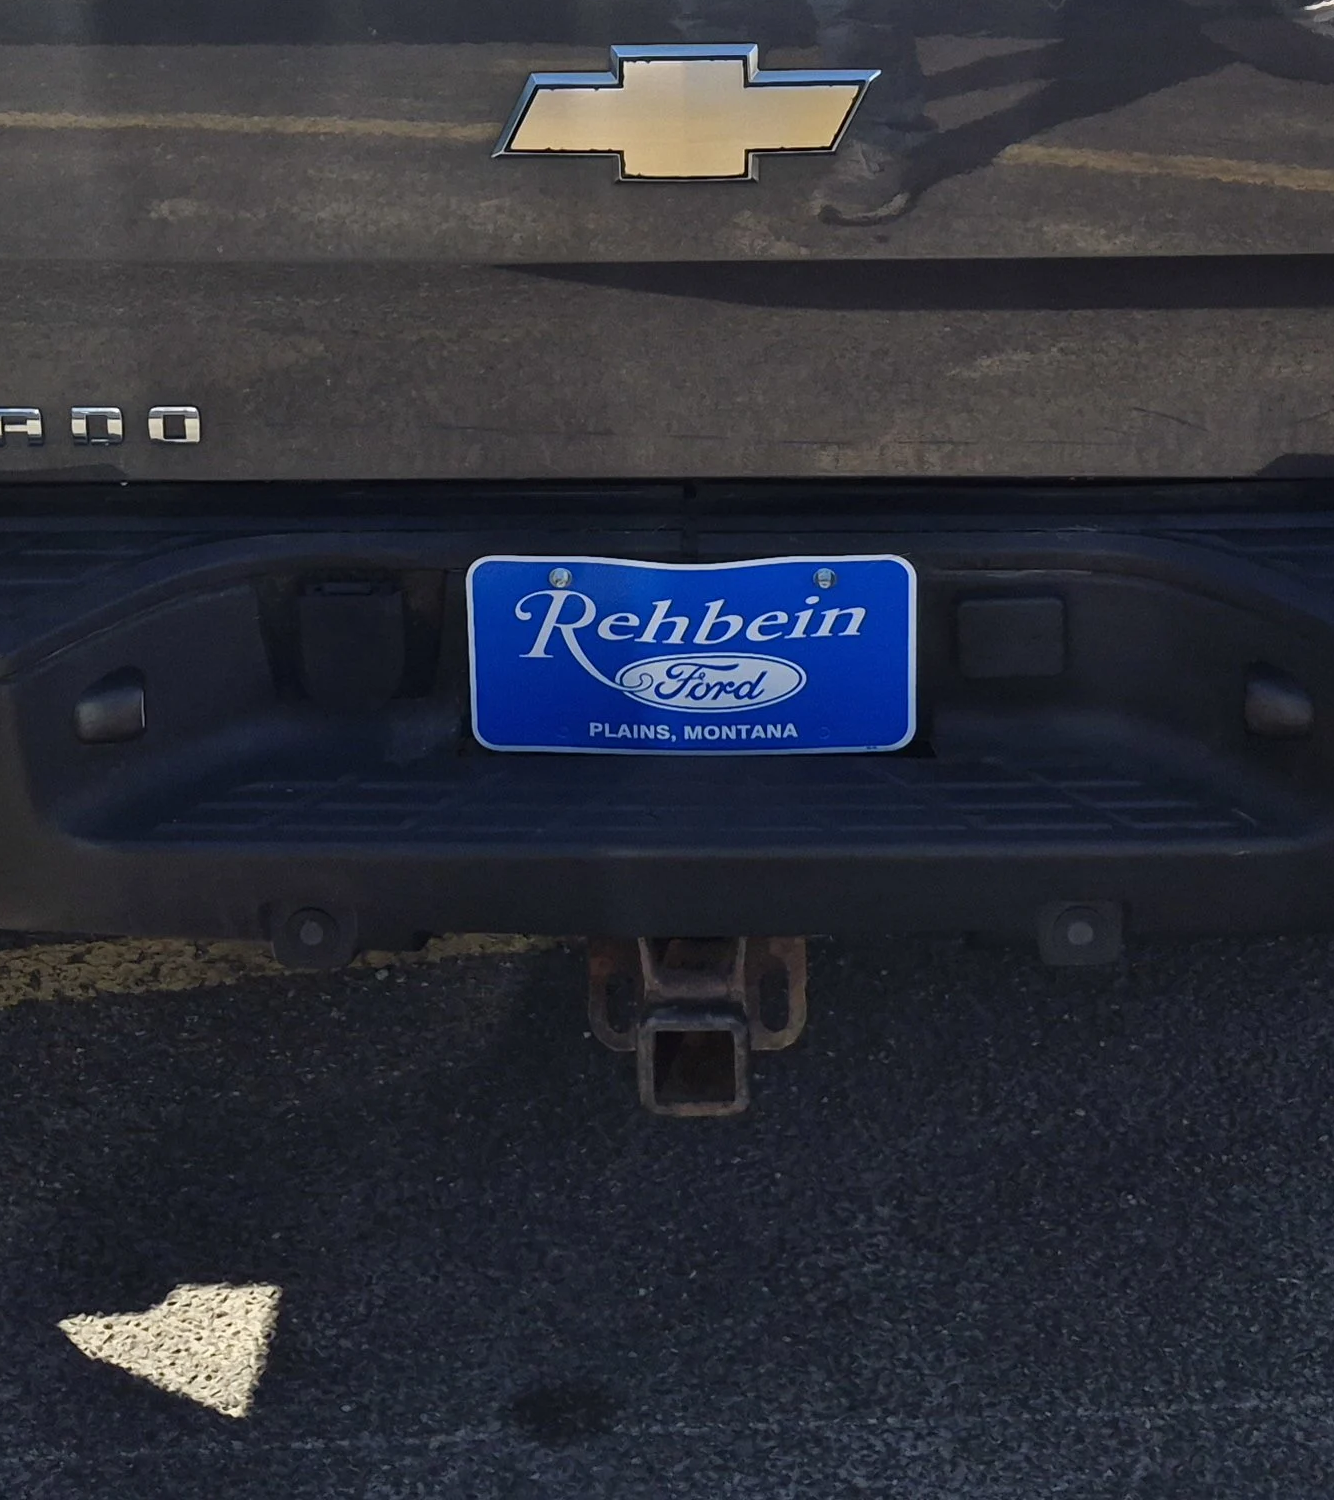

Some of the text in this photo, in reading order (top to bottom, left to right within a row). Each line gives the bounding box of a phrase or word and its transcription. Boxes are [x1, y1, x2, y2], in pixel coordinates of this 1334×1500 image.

[514, 589, 867, 691] Rehbein
[654, 662, 769, 700] Ford
[589, 722, 799, 743] PLAINS, MONTANA
